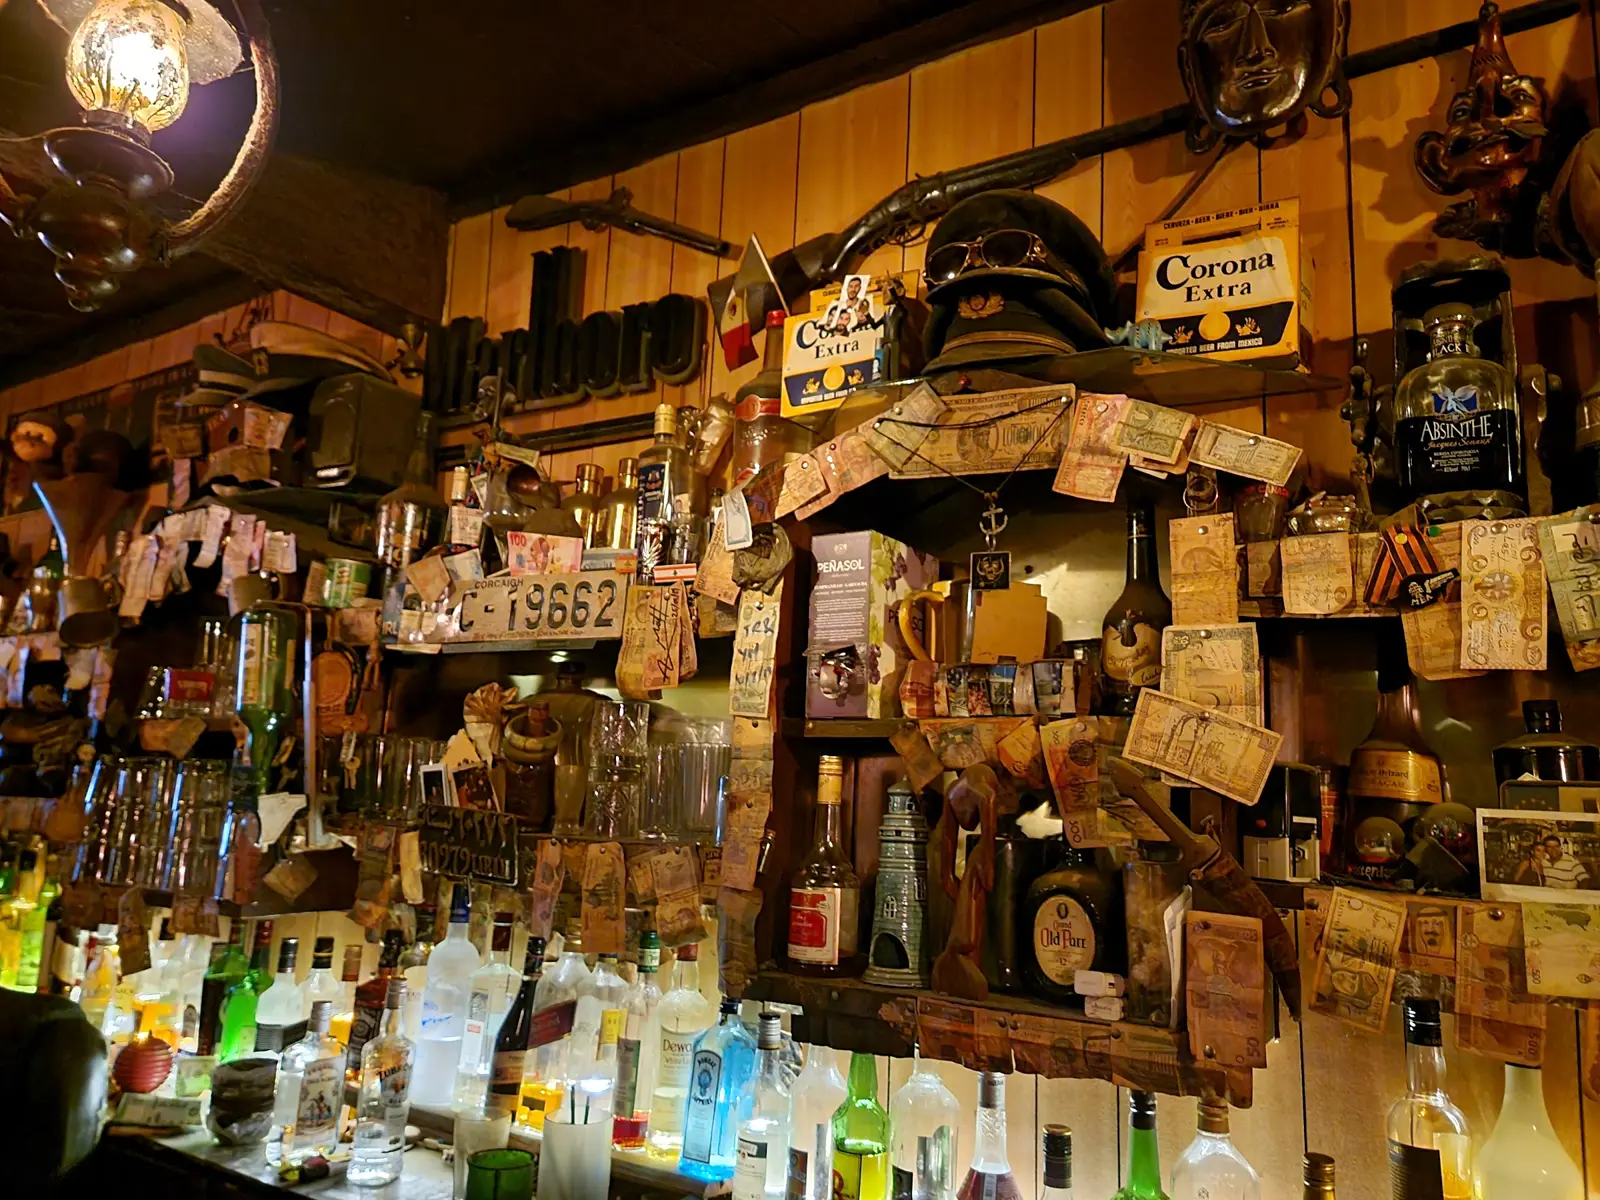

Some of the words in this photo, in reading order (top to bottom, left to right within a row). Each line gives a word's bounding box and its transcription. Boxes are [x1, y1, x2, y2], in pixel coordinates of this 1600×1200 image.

[1164, 216, 1190, 230] CERVEZA
[1195, 215, 1211, 224] BEER
[1216, 211, 1234, 221] BIERE
[1239, 207, 1254, 216] BIER
[1259, 202, 1280, 212] BIRRA
[1156, 252, 1275, 291] Corona
[1184, 281, 1252, 303] Extra
[815, 340, 860, 359] Extra
[1200, 343, 1215, 352] BEER
[1217, 340, 1236, 350] FROM
[1238, 337, 1263, 348] MEXICO
[1420, 414, 1494, 442] ABSINTHE
[509, 533, 527, 547] 100
[817, 559, 865, 573] PEÑASOL
[475, 578, 524, 590] CORCAIGH
[1068, 820, 1083, 844] 500
[1040, 928, 1060, 948] Old
[1062, 929, 1087, 950] Parr
